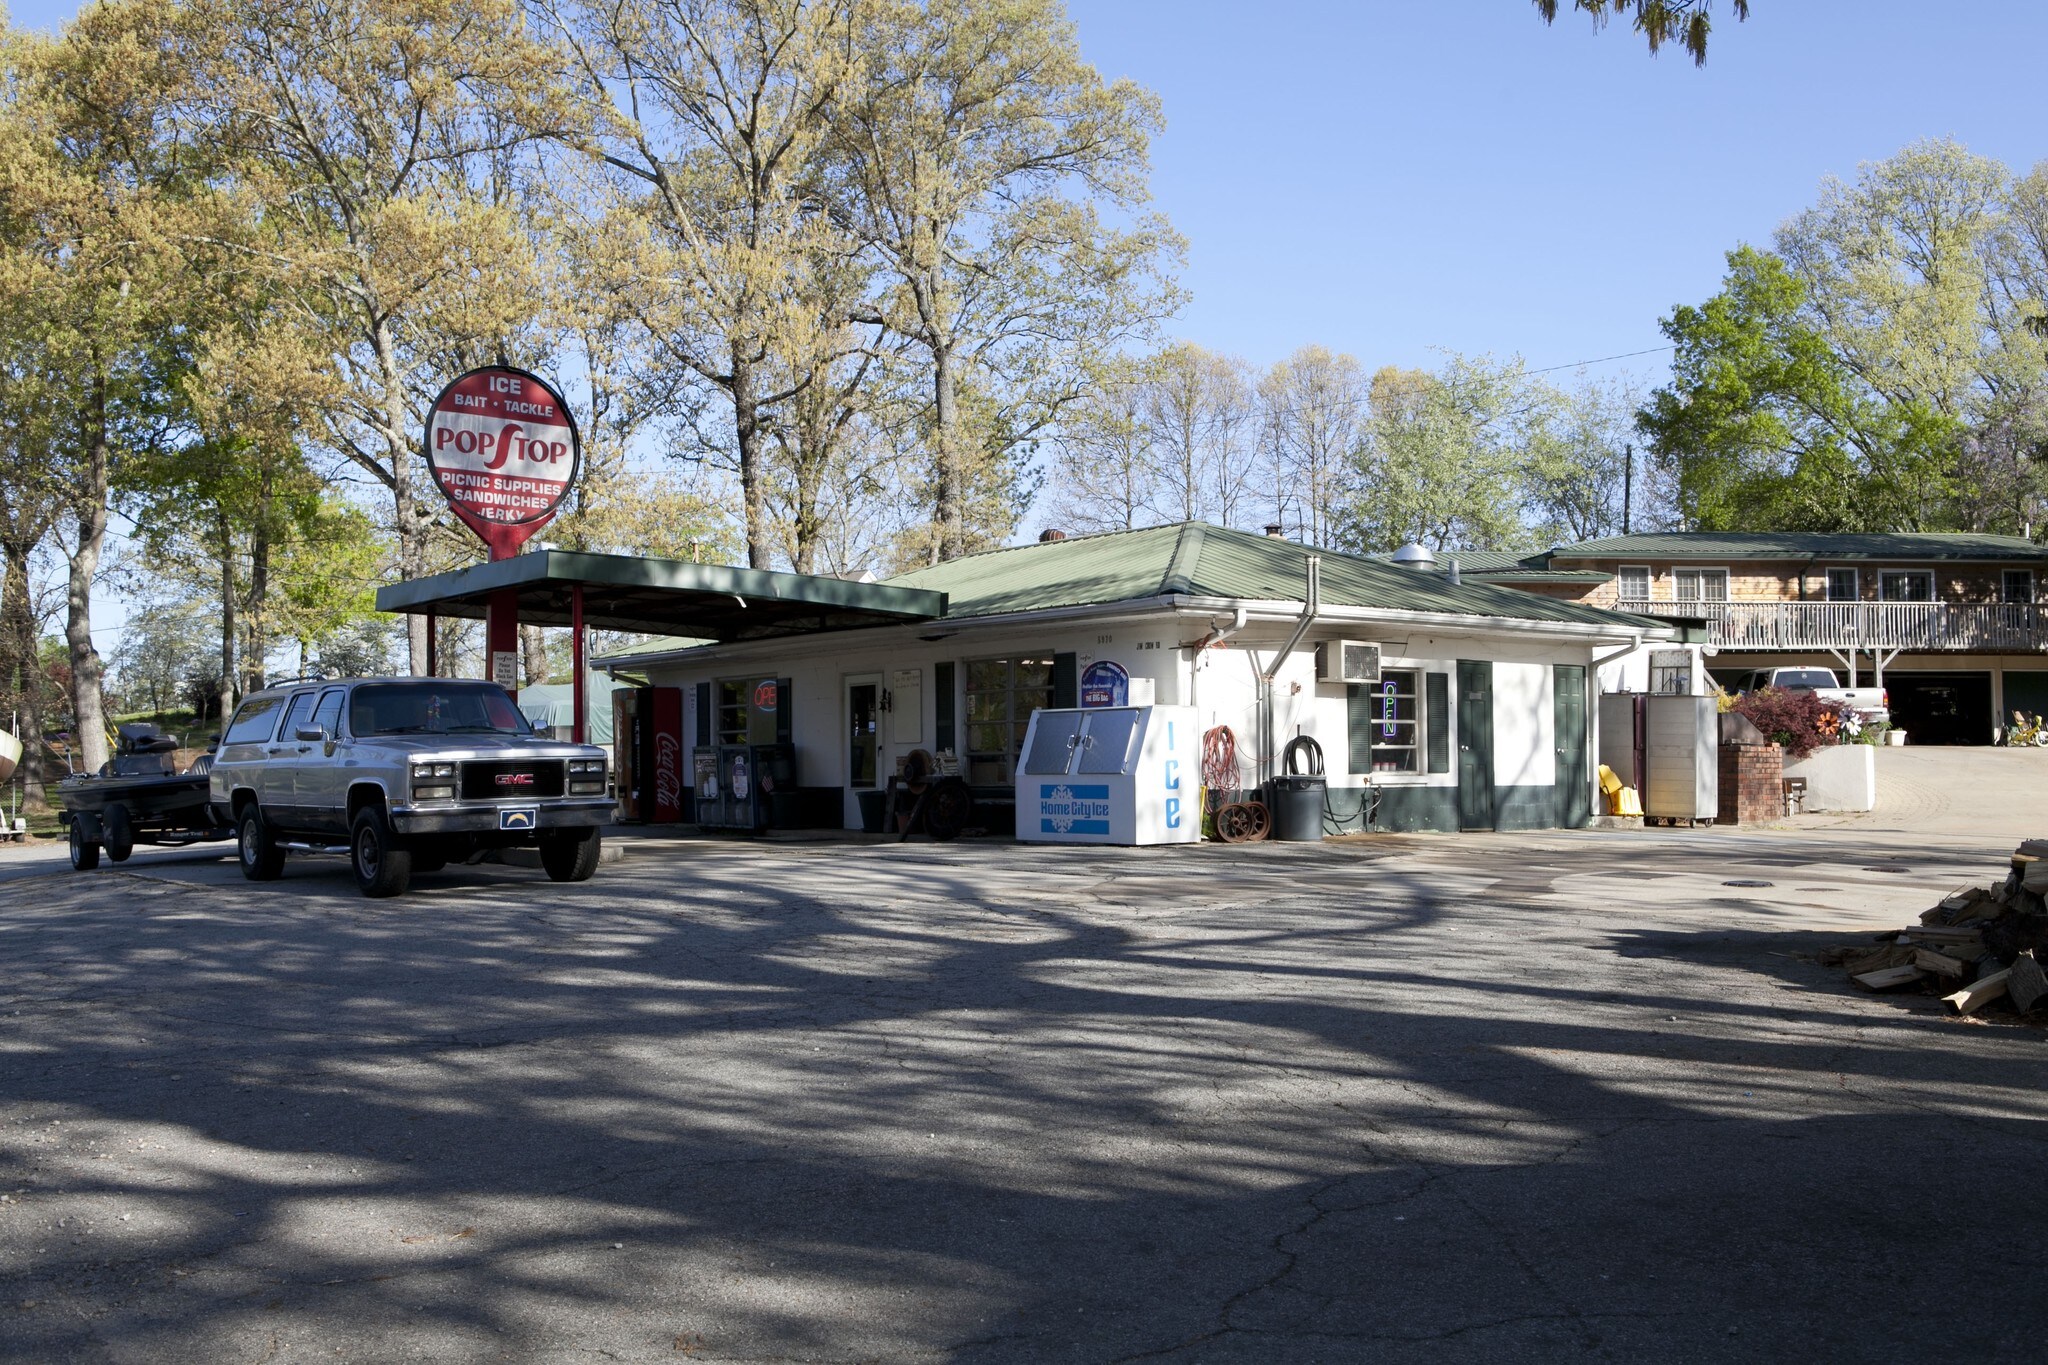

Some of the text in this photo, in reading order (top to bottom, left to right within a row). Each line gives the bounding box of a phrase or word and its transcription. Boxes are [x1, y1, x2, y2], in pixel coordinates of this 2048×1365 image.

[489, 375, 521, 395] ICE
[454, 393, 553, 417] BAIT TACKLE
[441, 472, 561, 496] PICNIC SUPPLIES
[453, 489, 549, 510] SANDWICHES
[477, 506, 525, 521] JERKY
[754, 686, 777, 706] OPE
[1385, 684, 1395, 734] OPEN
[495, 774, 534, 785] GMC
[1041, 801, 1109, 819] Home City Ice
